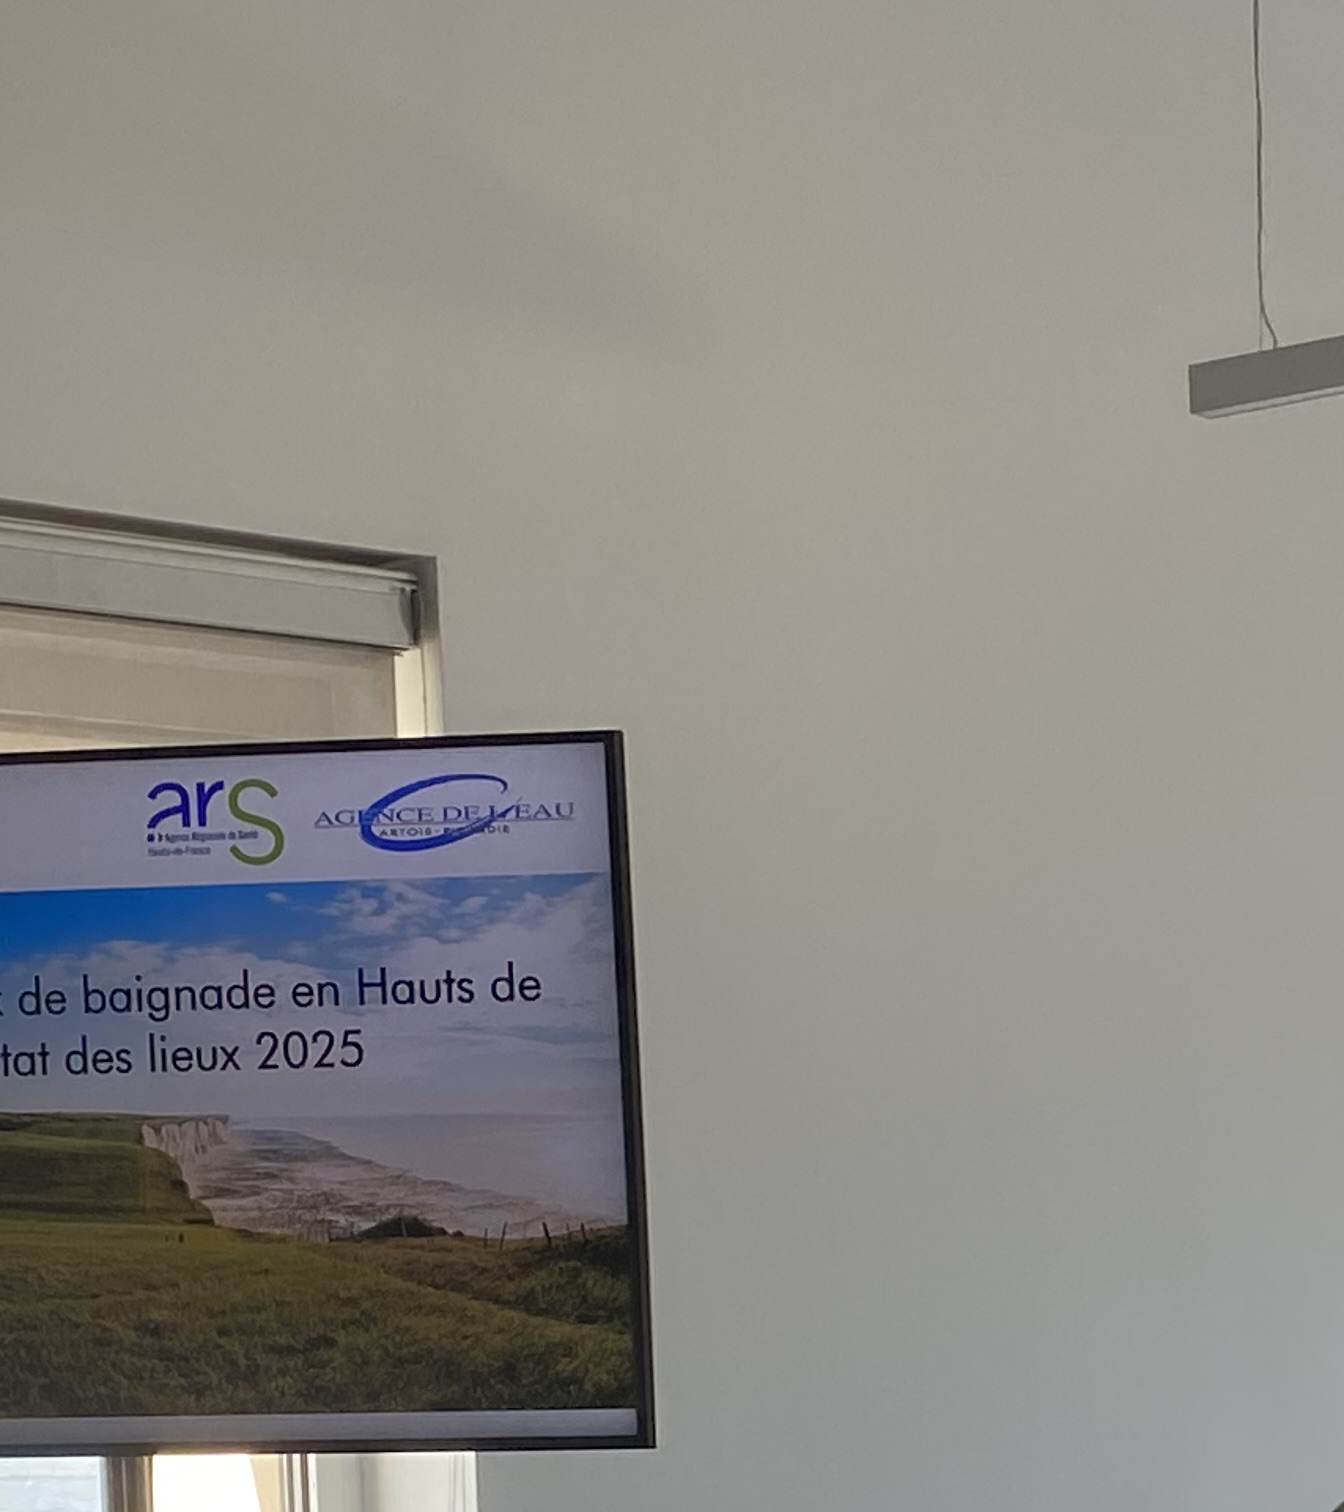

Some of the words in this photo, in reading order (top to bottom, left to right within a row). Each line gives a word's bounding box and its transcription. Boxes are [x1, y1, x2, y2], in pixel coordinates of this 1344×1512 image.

[147, 778, 284, 866] ars
[315, 807, 434, 826] AGENCE
[443, 804, 480, 822] DE
[19, 975, 67, 1015] de
[83, 968, 276, 1022] baignade
[292, 981, 340, 1008] en
[358, 967, 475, 1006] Hauts
[491, 961, 542, 1002] de
[0, 1042, 50, 1077] tat
[65, 1034, 132, 1075] des
[150, 1032, 241, 1072] lieux
[255, 1029, 364, 1070] 2025
